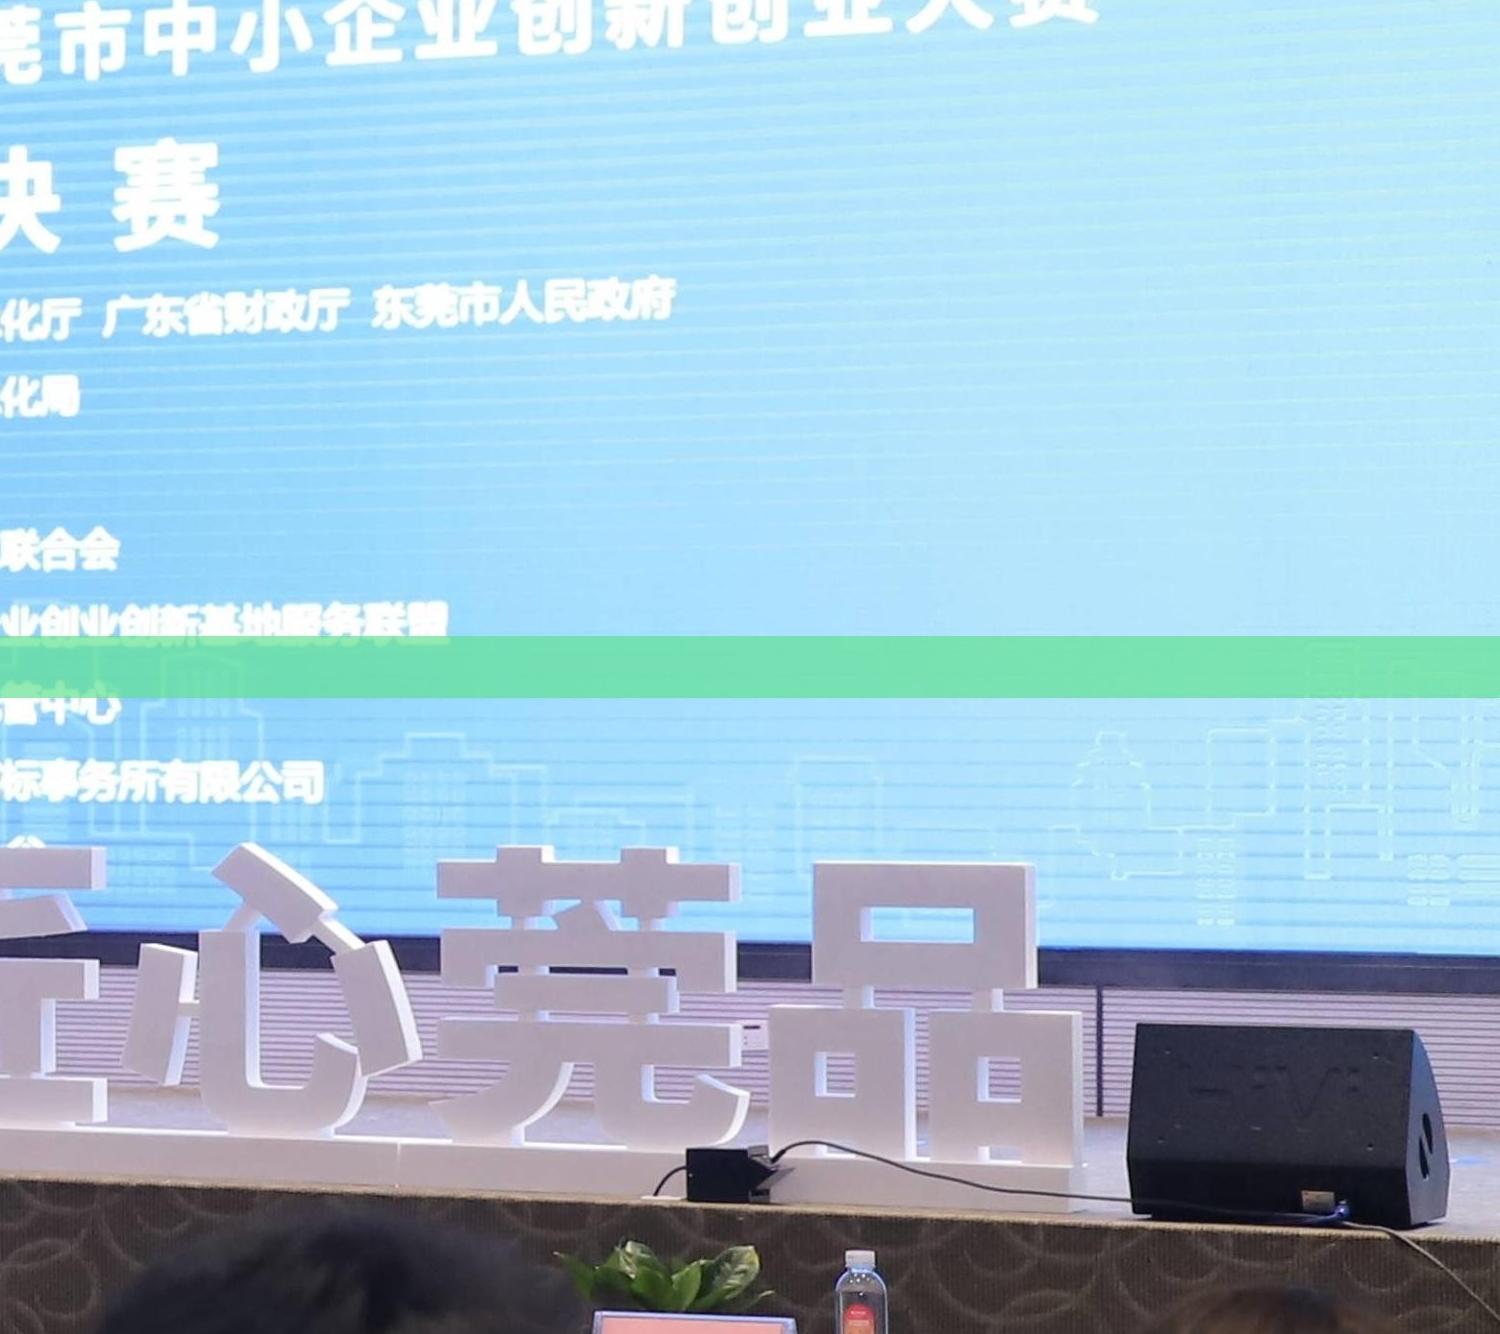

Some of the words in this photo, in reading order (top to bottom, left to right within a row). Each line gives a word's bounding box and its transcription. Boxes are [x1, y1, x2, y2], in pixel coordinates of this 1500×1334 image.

[102, 287, 351, 338] 广东省财政厅
[370, 273, 677, 328] 东莞市人民政府
